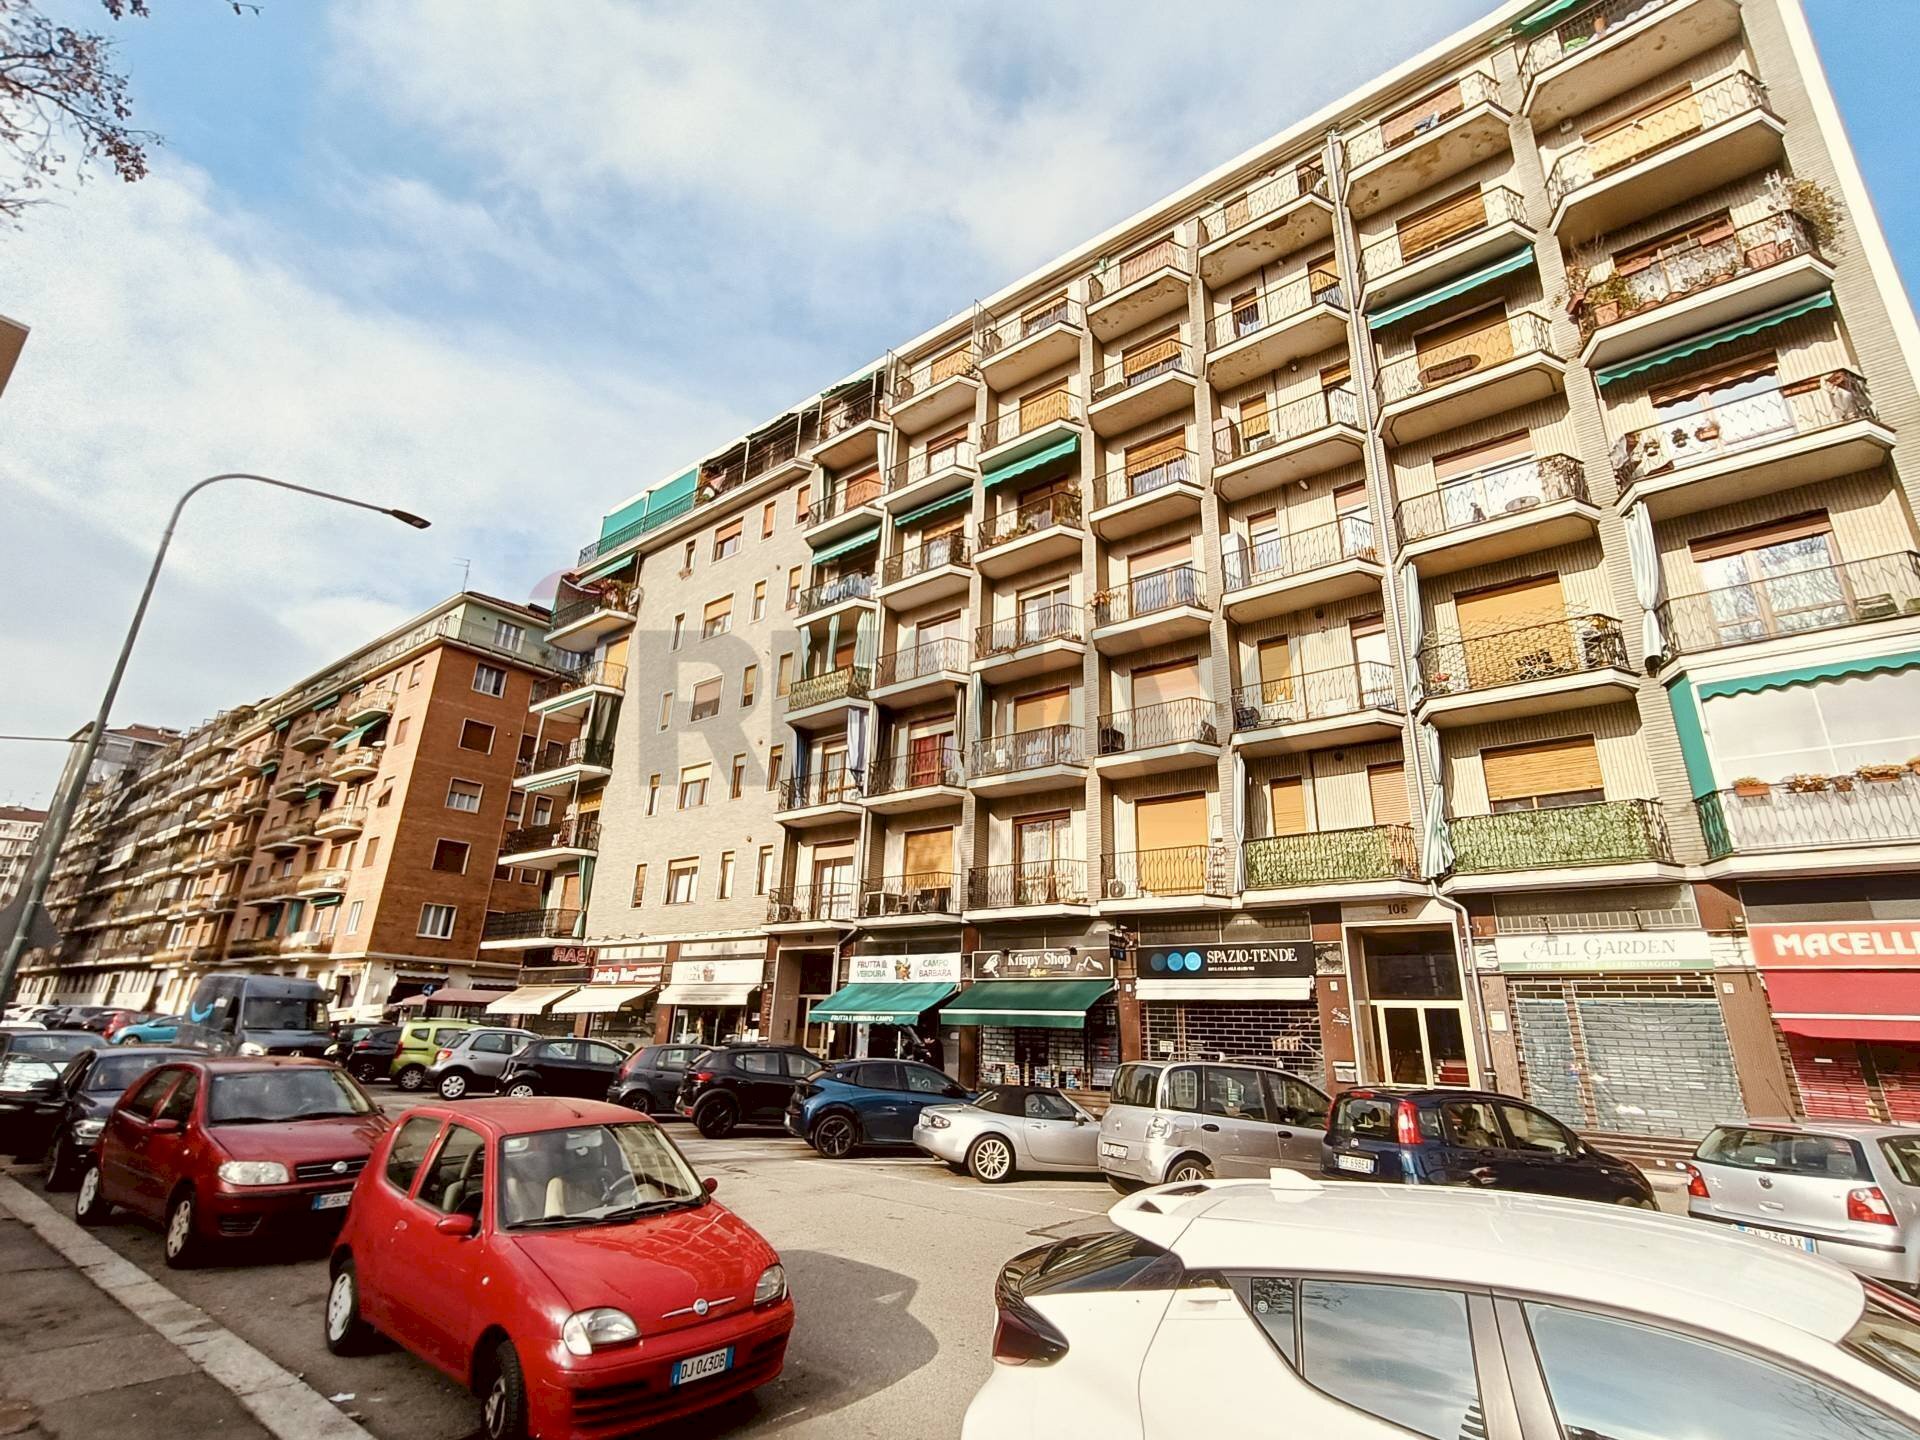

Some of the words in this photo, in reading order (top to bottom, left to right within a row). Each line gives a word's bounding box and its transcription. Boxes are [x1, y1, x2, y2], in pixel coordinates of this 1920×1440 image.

[1207, 948, 1297, 963] SPAZIO-TENDE
[1584, 936, 1676, 960] GARDEN
[1007, 953, 1040, 968] Krispy
[1044, 952, 1071, 968] Shop
